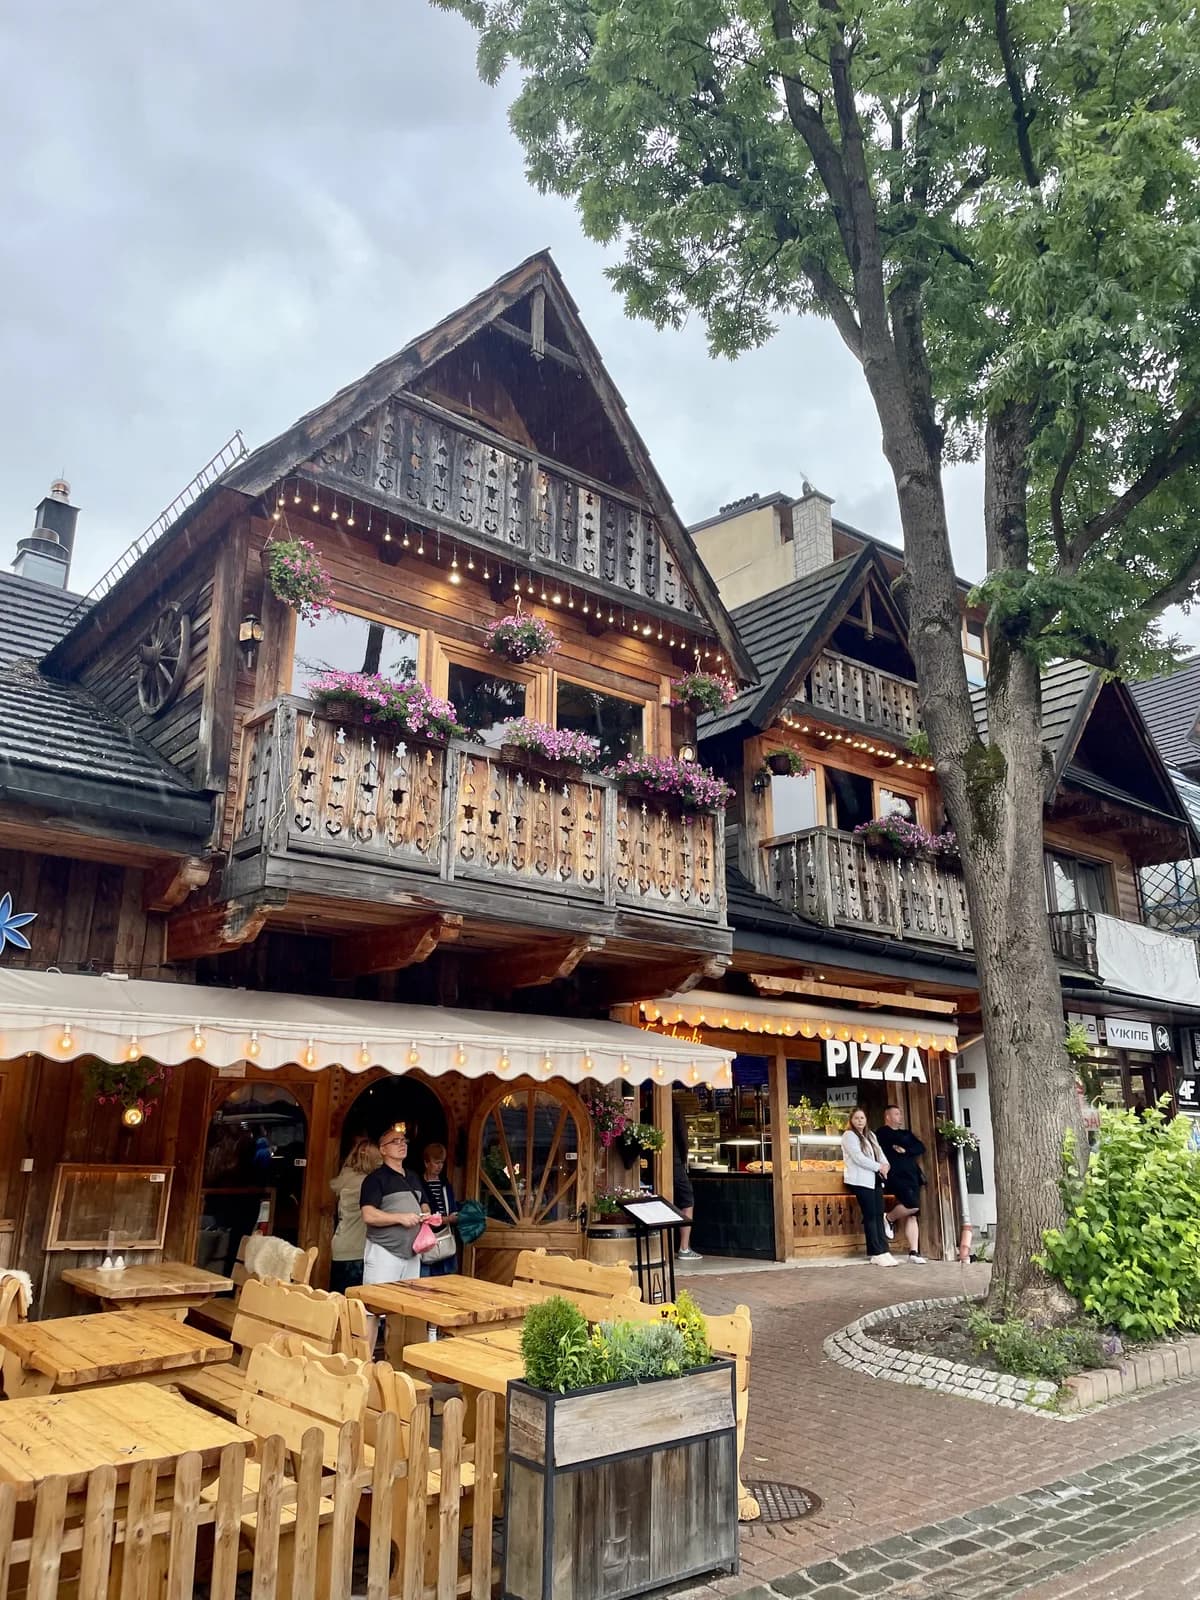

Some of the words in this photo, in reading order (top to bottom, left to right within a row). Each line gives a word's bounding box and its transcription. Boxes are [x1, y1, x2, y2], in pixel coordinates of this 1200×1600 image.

[1110, 1027, 1149, 1041] VIKING
[826, 1039, 928, 1083] PIZZA
[1178, 1080, 1196, 1100] 4F
